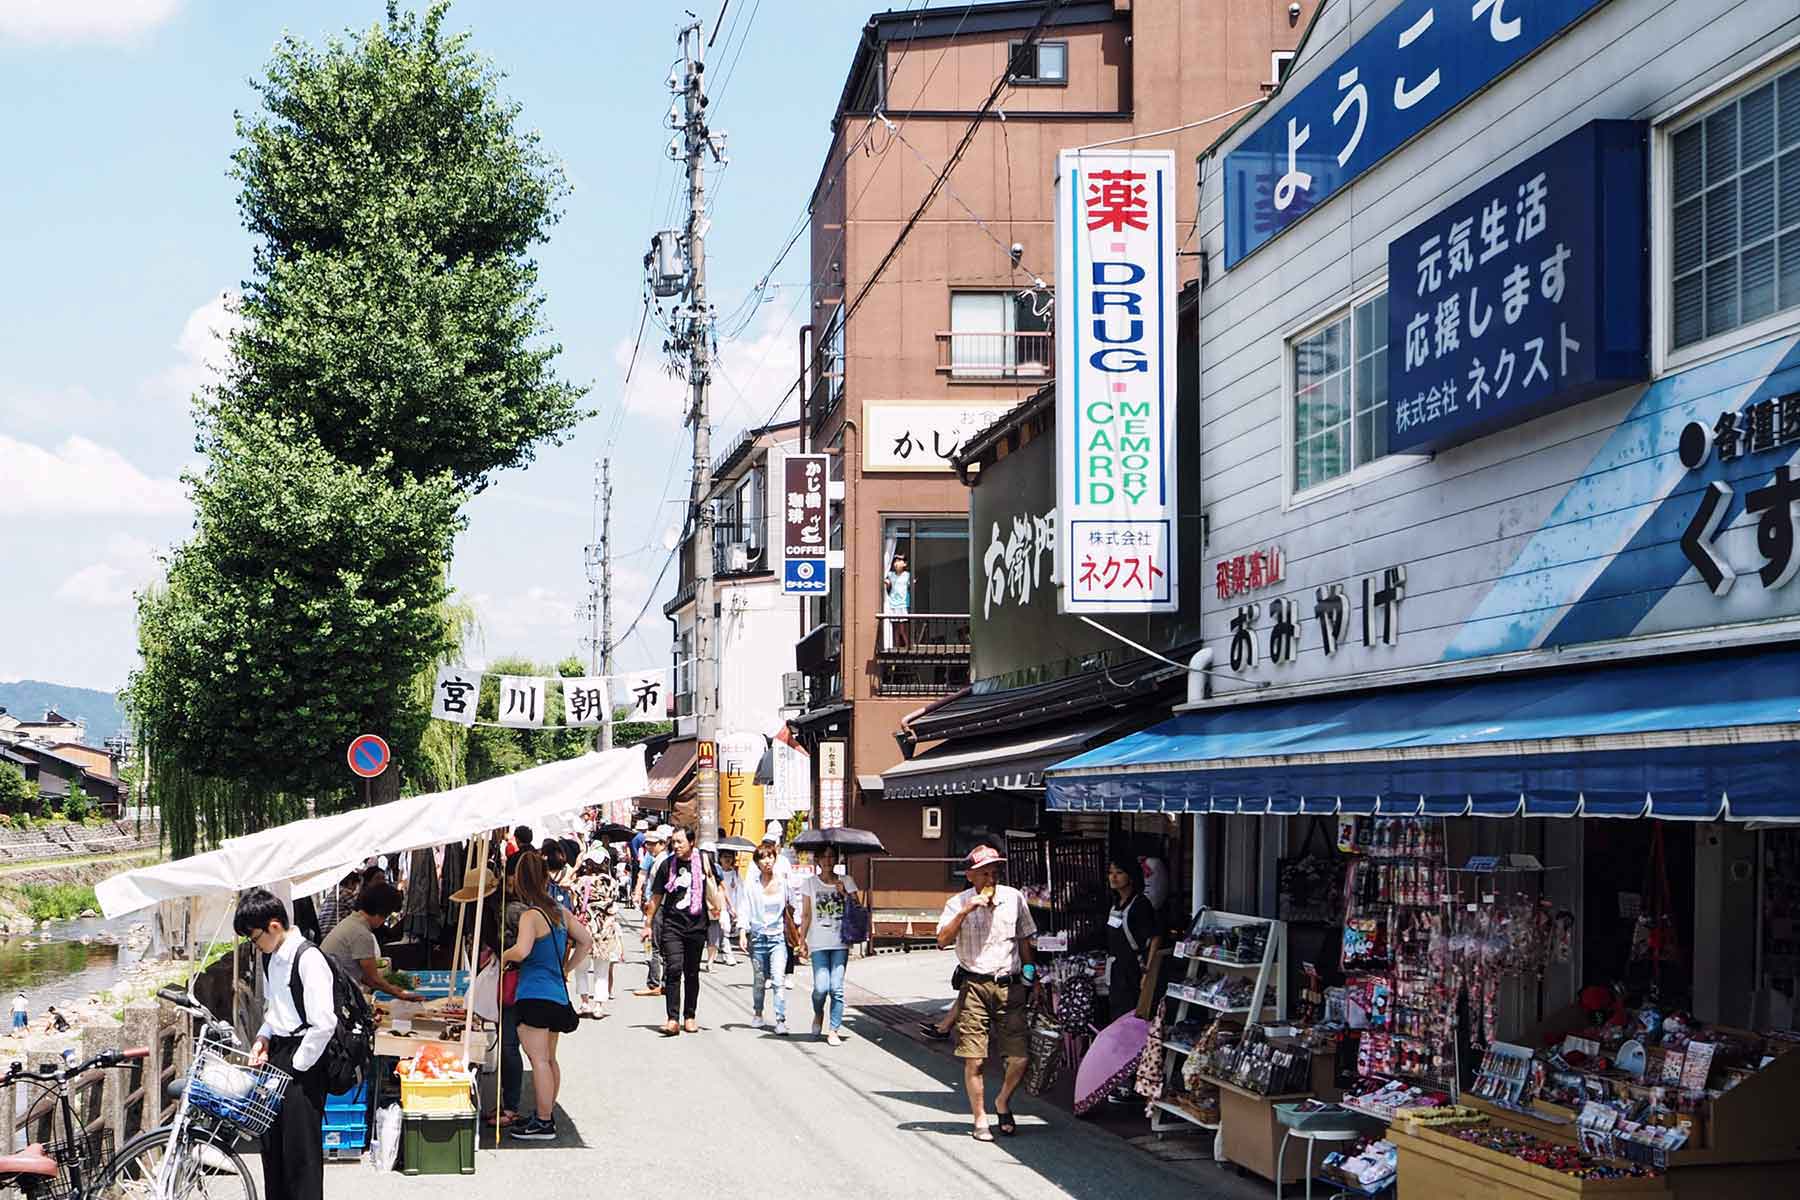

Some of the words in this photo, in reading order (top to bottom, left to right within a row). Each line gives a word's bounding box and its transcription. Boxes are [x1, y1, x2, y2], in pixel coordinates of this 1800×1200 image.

[1086, 170, 1149, 232] 薬
[1417, 172, 1548, 297] 元気生活
[1089, 262, 1148, 373] DRUG
[1405, 243, 1571, 372] 応援します
[1396, 378, 1458, 433] 株式会社
[1466, 322, 1580, 410] ネクスト
[1087, 402, 1115, 504] CARD
[1120, 402, 1150, 504] MEMORY
[786, 546, 825, 554] COFFEE
[788, 492, 804, 524] 珈琲
[1089, 530, 1152, 546] 株式会社
[1079, 554, 1164, 591] ネクスト
[1230, 565, 1407, 673] おみやげ
[440, 676, 661, 722] 宮川朝市
